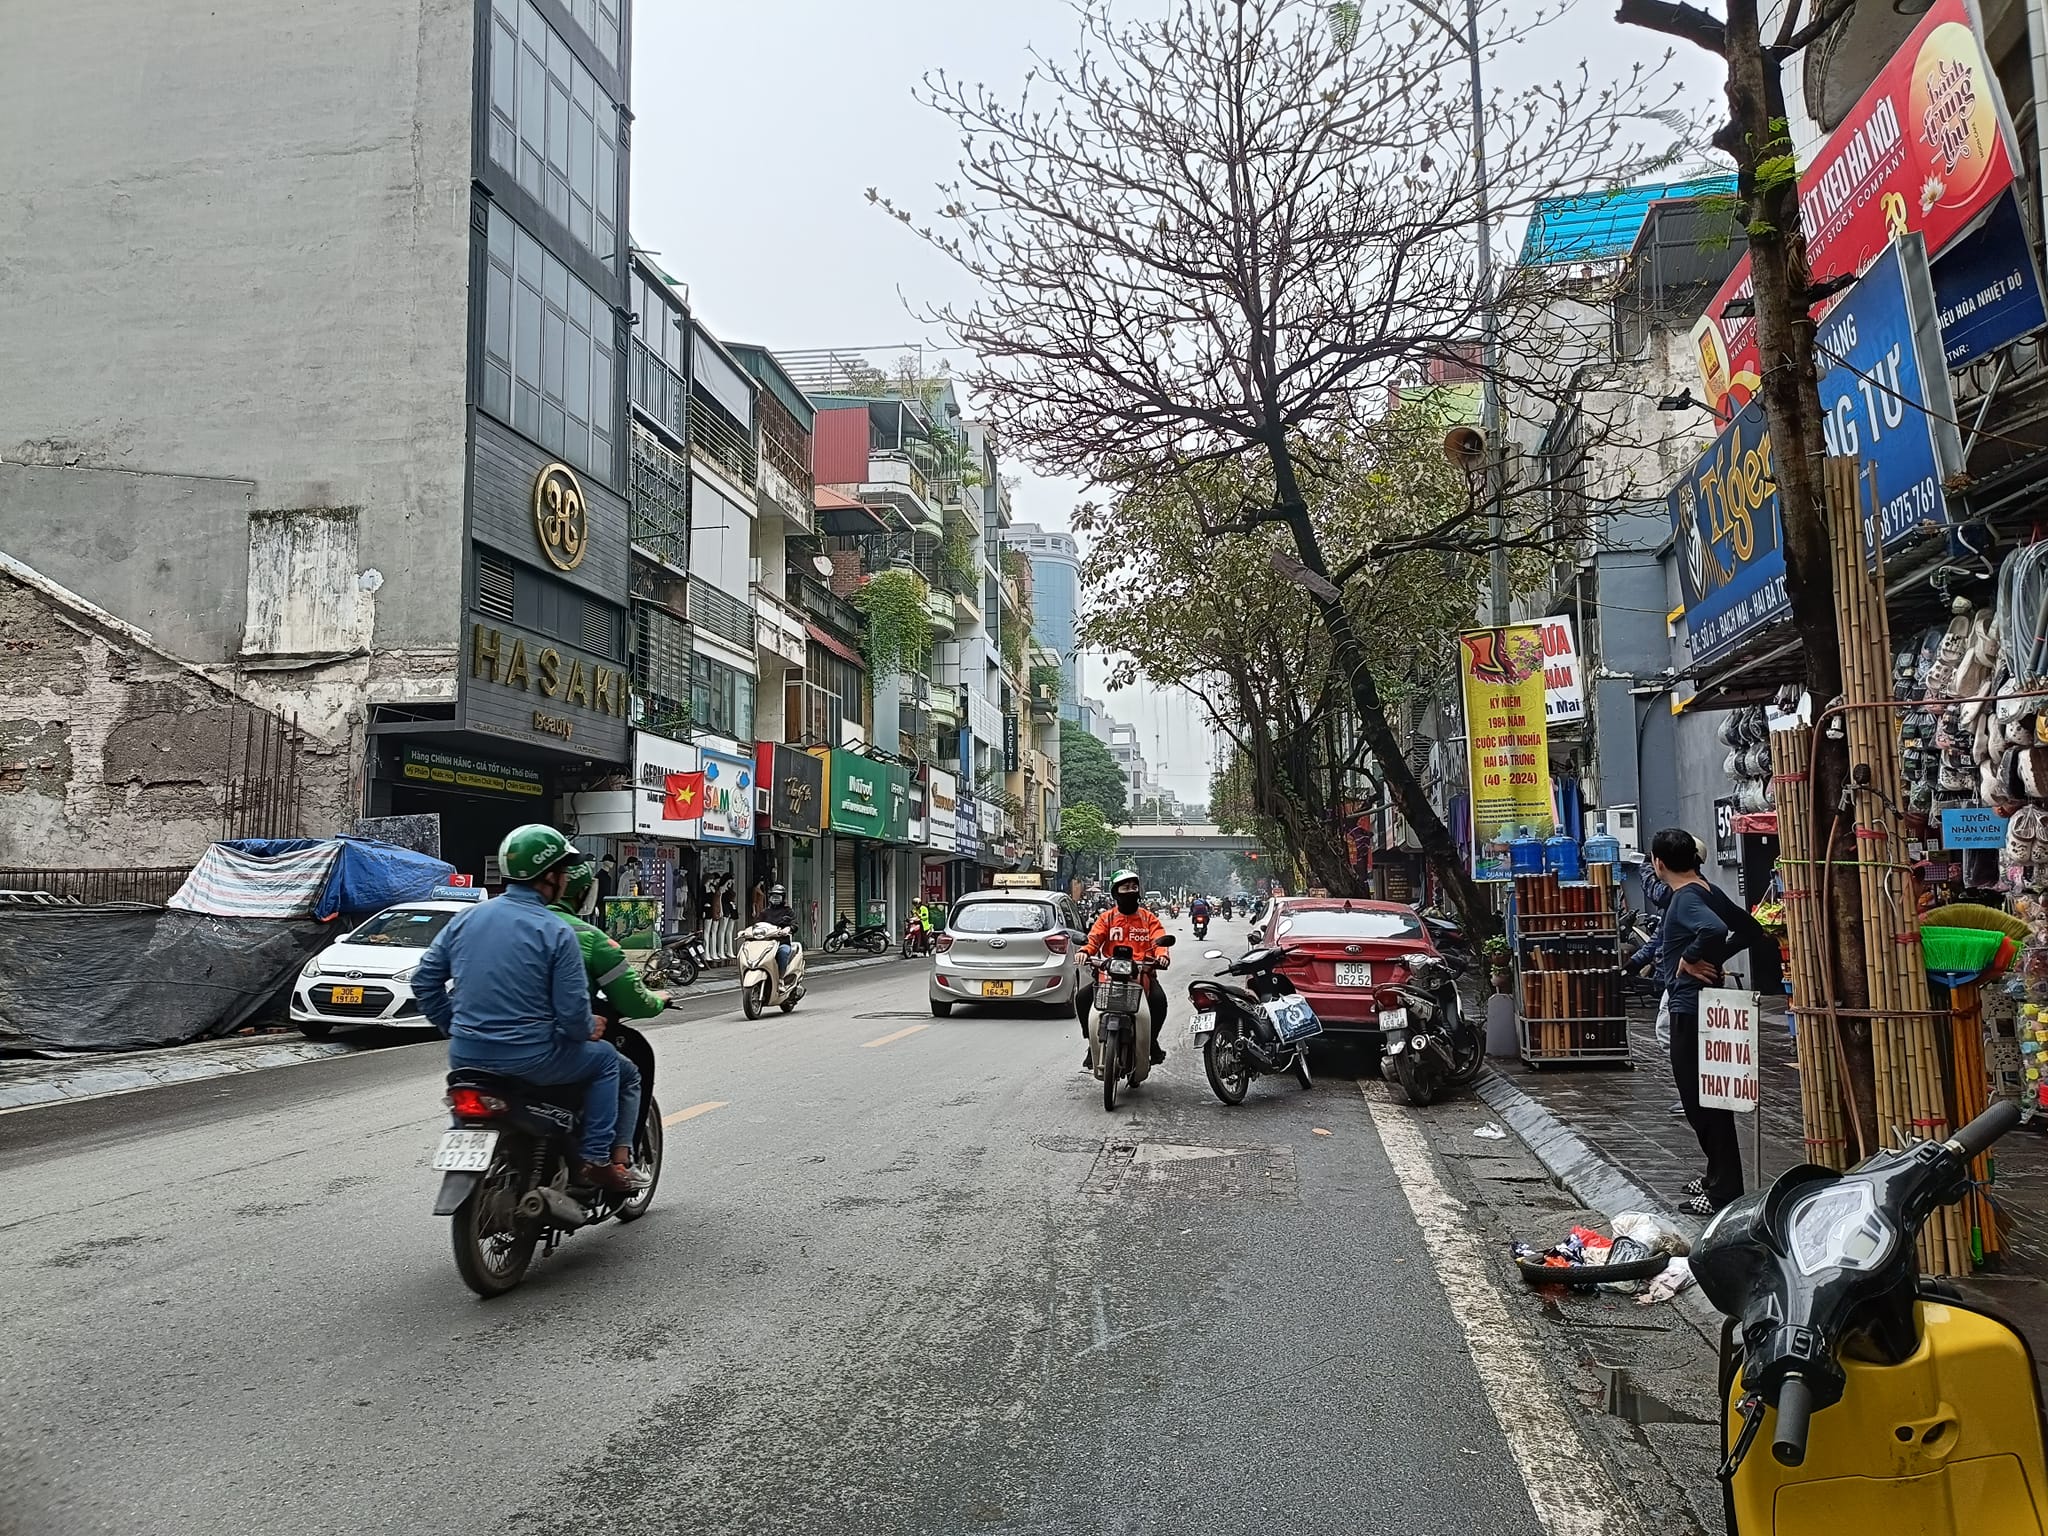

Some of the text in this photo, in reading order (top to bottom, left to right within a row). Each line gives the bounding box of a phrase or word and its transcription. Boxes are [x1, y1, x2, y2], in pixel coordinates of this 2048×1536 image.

[1818, 154, 1851, 218] KẸO
[1844, 126, 1873, 188] HÀ
[1864, 93, 1901, 156] NỘI
[1807, 239, 1826, 267] OINT
[1827, 206, 1855, 244] STOCK
[1857, 145, 1906, 209] COMPANY
[1955, 296, 1976, 320] HÒA
[1976, 280, 2006, 308] NHIỆT
[2006, 267, 2023, 292] ĐỘ
[1824, 313, 1858, 370] HÀNG
[1857, 342, 1903, 443] TƯ
[1699, 424, 1777, 561] Tiger
[1890, 491, 1913, 531] 975
[1911, 476, 1935, 518] 769
[1708, 621, 1717, 645] 61
[1718, 609, 1737, 640] BẠCH
[1734, 599, 1750, 628] MAI
[1751, 588, 1767, 618] HAI
[1764, 576, 1778, 610] BÀ
[1541, 623, 1572, 657] ƯA
[473, 623, 626, 719] HASAKI
[1556, 698, 1580, 714] Mai
[533, 711, 573, 741] Beauty
[1488, 716, 1506, 729] 1984
[1475, 734, 1497, 750] CUỘC
[1516, 731, 1541, 747] NGHĨA
[430, 753, 453, 766] CHÍNH
[476, 761, 488, 771] GIÁ
[1483, 755, 1497, 768] HAI
[1484, 773, 1500, 787] (40
[1509, 772, 1538, 785] 2024)
[704, 785, 730, 813] SAM
[1979, 825, 2001, 833] VIÊN
[531, 843, 559, 865] Grab
[1344, 963, 1363, 974] 30G
[1706, 998, 1750, 1032] SỬA XE
[1705, 1038, 1752, 1066] BƠM VÁ
[1700, 1071, 1758, 1102] THAY DẦU
